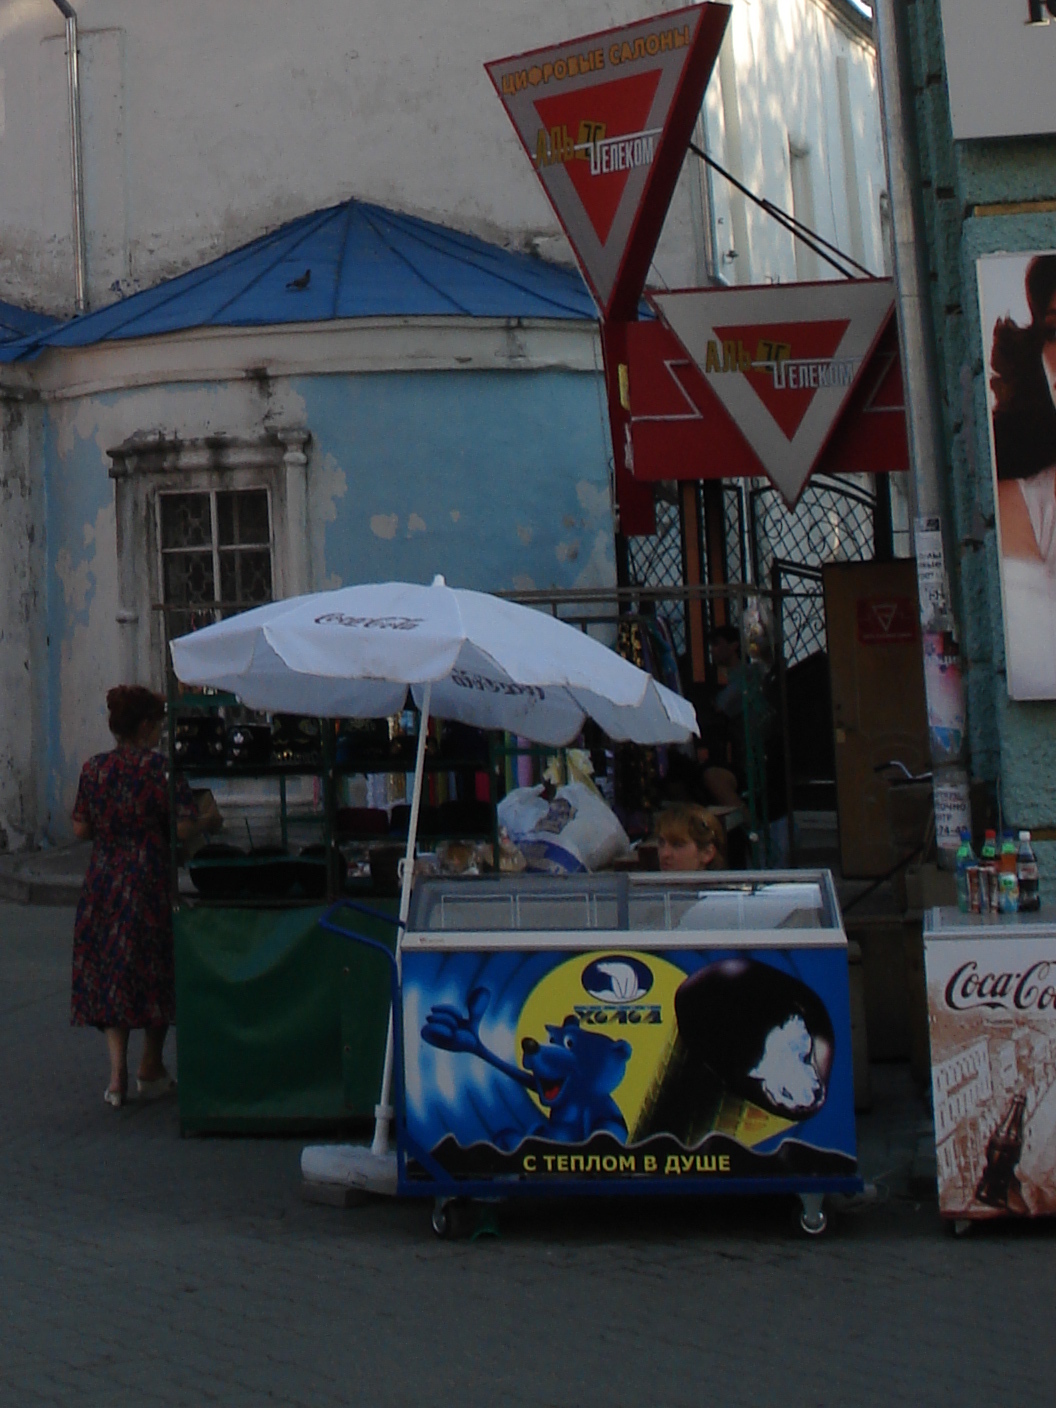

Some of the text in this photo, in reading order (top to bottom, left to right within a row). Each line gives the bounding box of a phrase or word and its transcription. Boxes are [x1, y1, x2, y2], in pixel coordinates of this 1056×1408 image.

[502, 26, 690, 95] ЦИФРОВЫЕ САЛОНЫ
[314, 612, 425, 630] Coca-Cola
[523, 1155, 731, 1176] С ТЕПЛОМ В ДУШЕ
